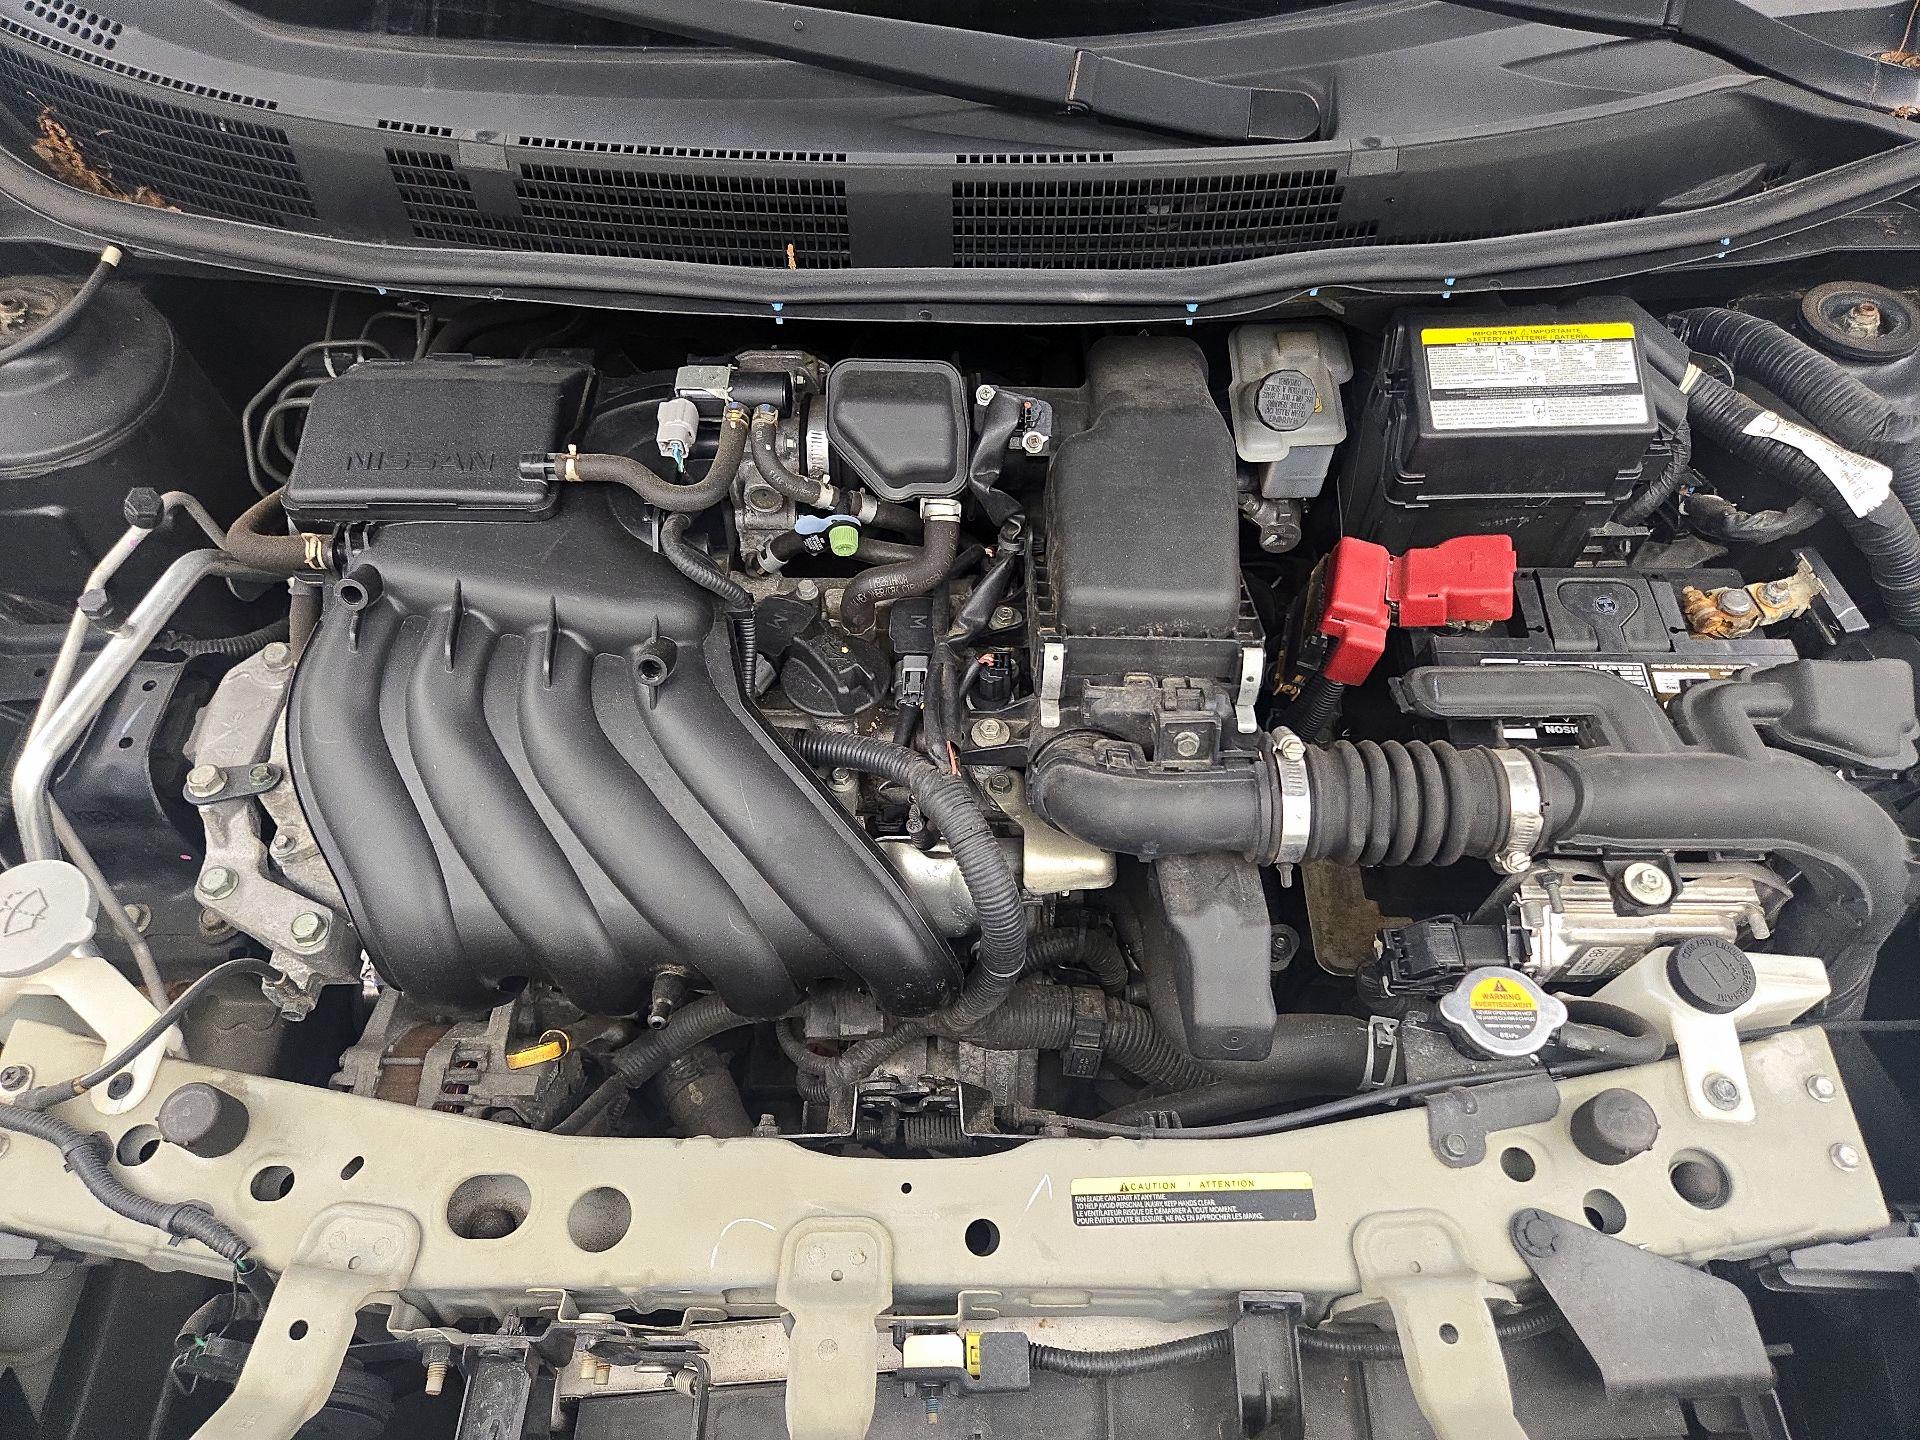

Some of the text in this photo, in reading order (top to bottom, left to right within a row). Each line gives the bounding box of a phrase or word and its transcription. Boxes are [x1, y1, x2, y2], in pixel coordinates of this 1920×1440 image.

[347, 451, 495, 471] NISSAN
[1130, 1182, 1176, 1191] CAUTION
[1200, 1180, 1255, 1188] ATTENTION
[1116, 1201, 1144, 1209] PERSONAL
[1084, 1209, 1122, 1217] VENTILATEUR
[1123, 1208, 1145, 1216] RISQUE
[1192, 1206, 1208, 1214] TOUT
[1196, 1213, 1231, 1221] APPROCHER
